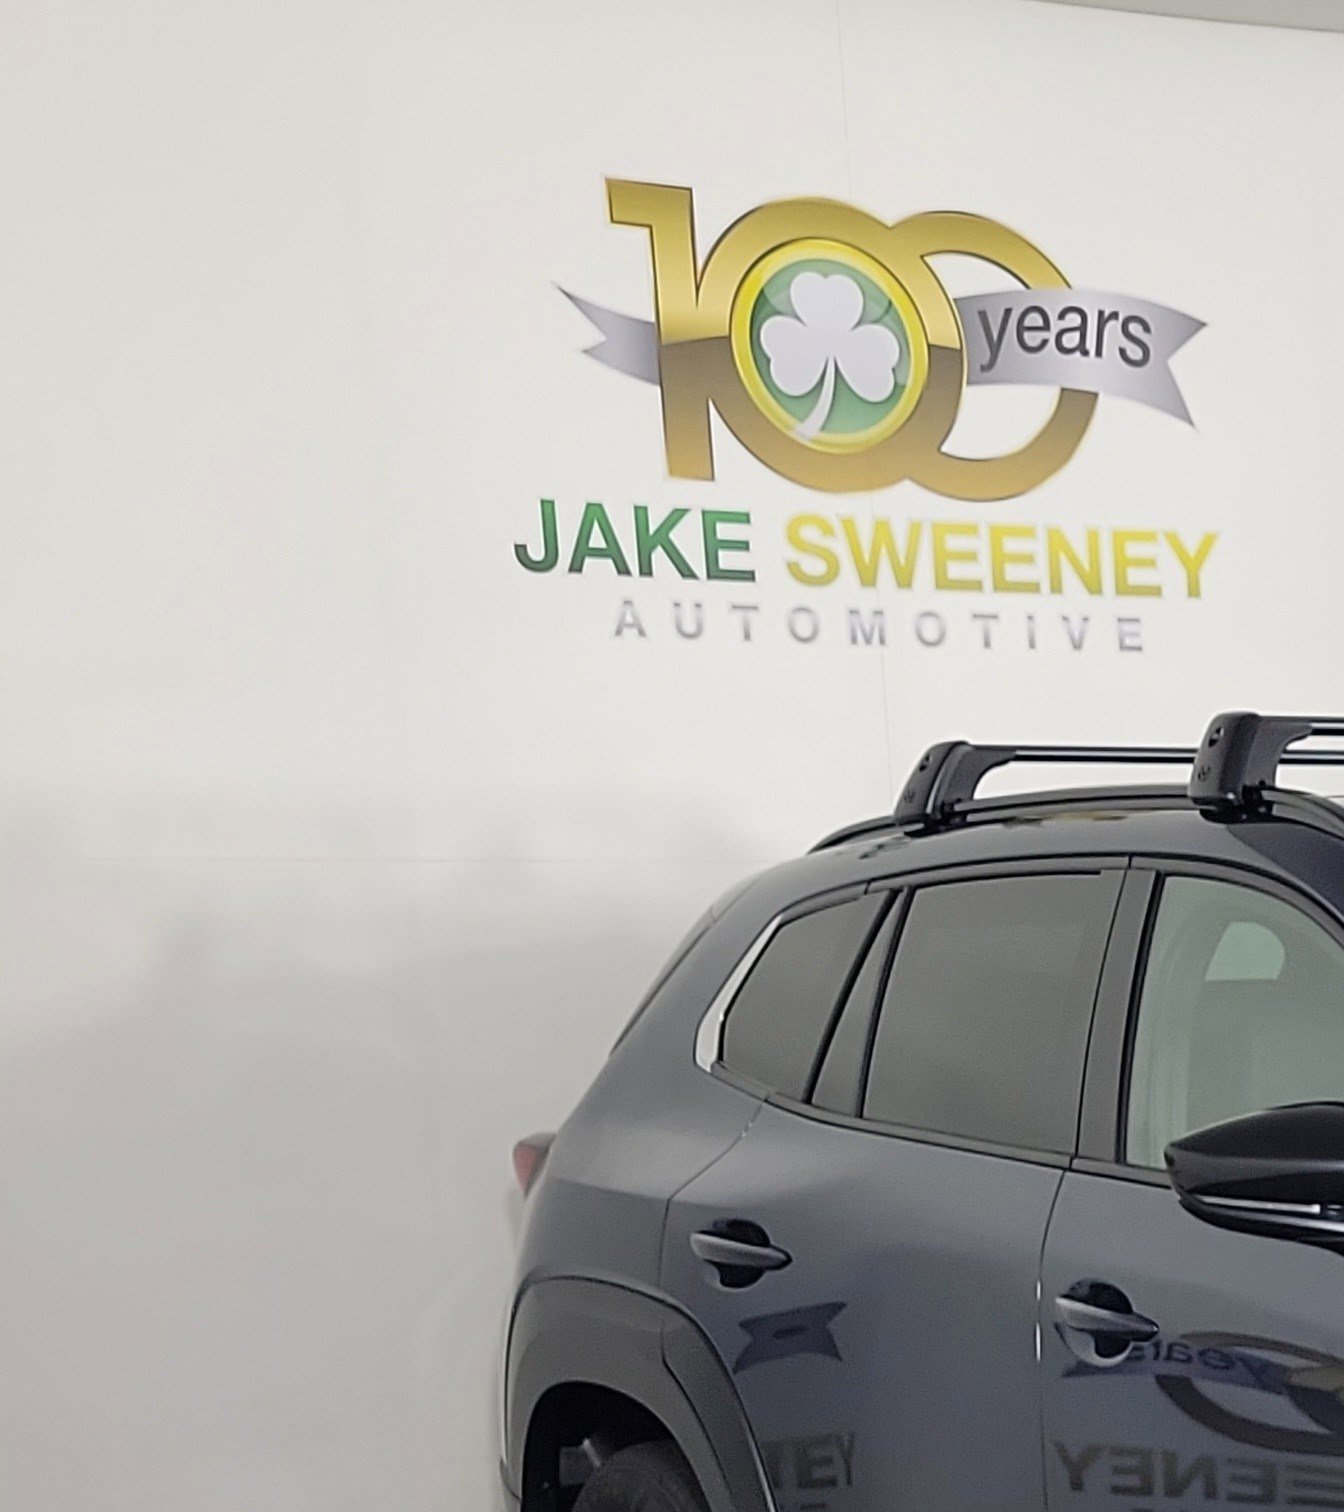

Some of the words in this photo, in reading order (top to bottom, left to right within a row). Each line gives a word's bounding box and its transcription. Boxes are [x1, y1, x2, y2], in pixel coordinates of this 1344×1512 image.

[605, 176, 1098, 503] 100
[976, 303, 1153, 373] years
[514, 499, 756, 583] JAKE
[786, 515, 1220, 598] SWEENEY
[613, 600, 1145, 653] AUTOMOTIVE
